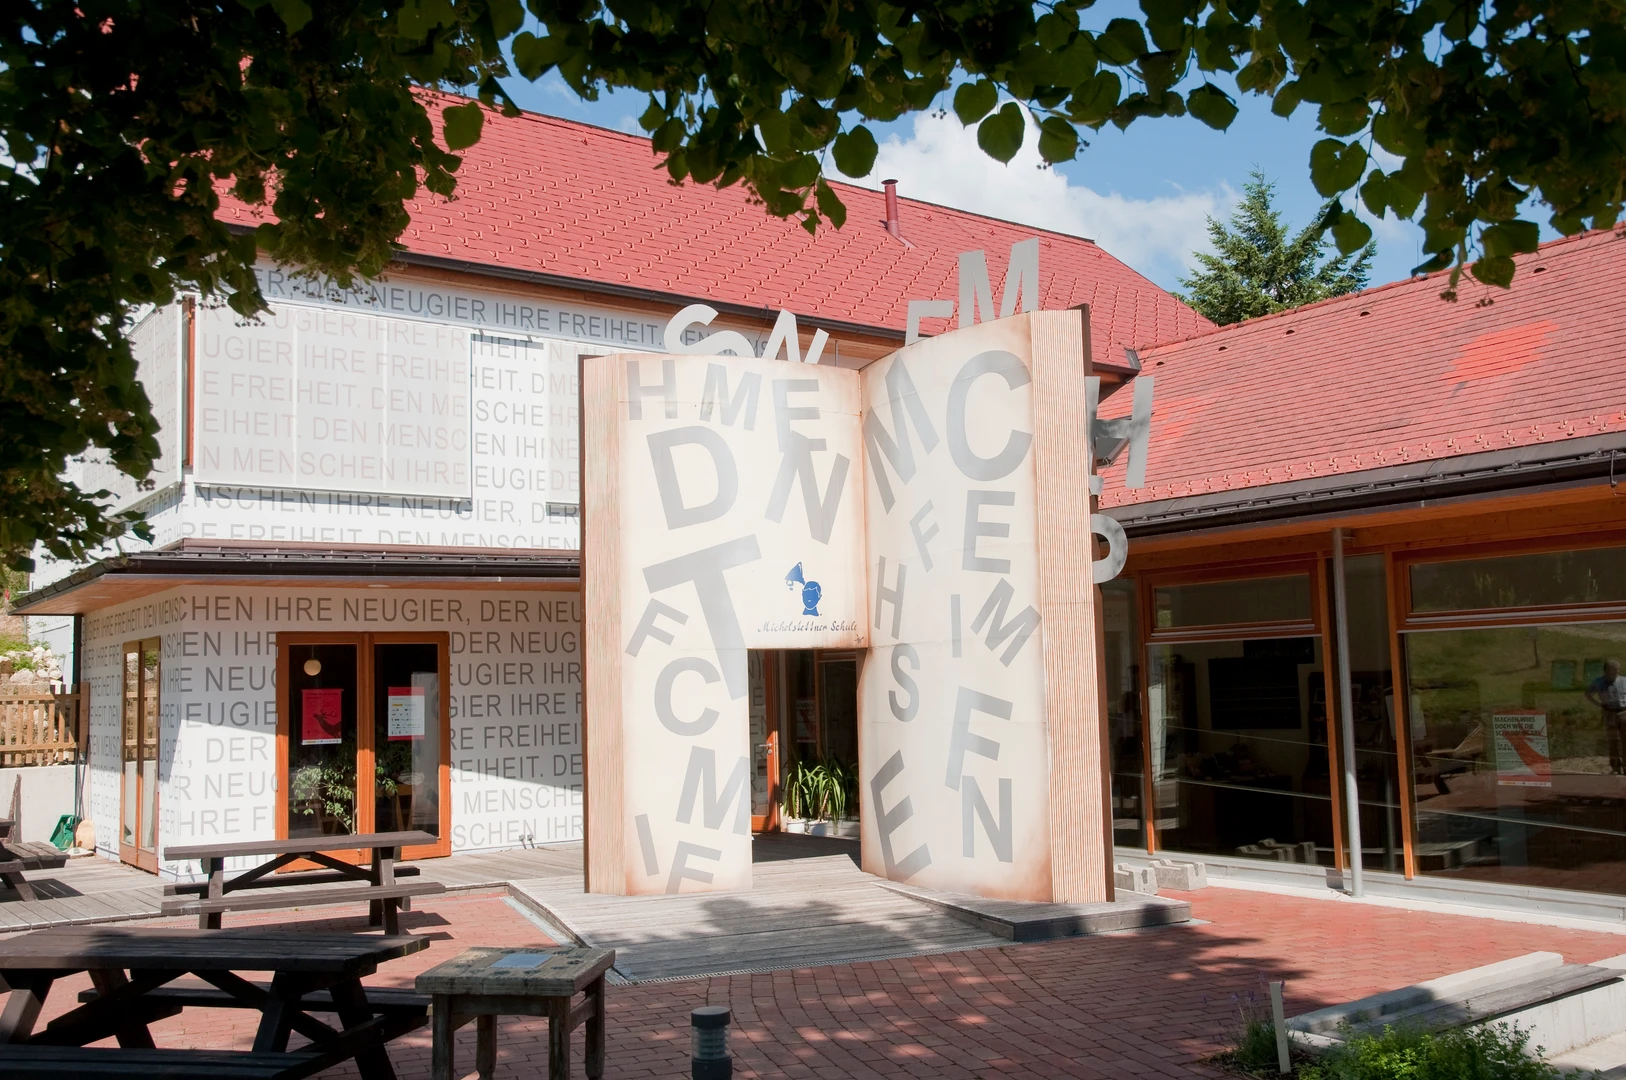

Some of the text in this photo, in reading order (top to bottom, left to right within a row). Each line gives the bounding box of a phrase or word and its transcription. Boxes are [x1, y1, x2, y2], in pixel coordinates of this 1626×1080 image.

[371, 285, 486, 322] NEUGIER
[495, 303, 551, 331] IHRE
[559, 311, 662, 346] FREIHEIT.
[203, 333, 467, 385] UGIER IHRE FREIHE
[231, 373, 361, 408] FREIHEIT.
[371, 386, 422, 414] DEN
[432, 392, 467, 418] ME
[475, 399, 544, 428] SCHE
[626, 360, 678, 420] H
[699, 362, 762, 431] M
[946, 349, 1033, 482] C
[202, 407, 467, 451] EIHEIT. DEN MENSC
[475, 432, 506, 457] EN
[862, 351, 940, 515] M
[233, 447, 396, 481] MENSCHEN
[406, 459, 467, 486] IHRE
[646, 425, 738, 530] D
[764, 429, 850, 546] N
[329, 492, 391, 517] IHRE
[401, 496, 522, 526] NEUGIER,
[909, 499, 940, 573] F
[962, 490, 1016, 574] E
[266, 596, 332, 622] IHRE
[343, 597, 470, 625] NEUGIER,
[480, 599, 530, 623] DER
[624, 597, 689, 658] F
[642, 534, 763, 701] T
[830, 620, 858, 632] Schule
[874, 555, 907, 640] H
[970, 577, 1042, 668] M
[452, 631, 501, 654] DER
[205, 665, 276, 692] NEU
[450, 662, 535, 687] UGIER
[511, 692, 567, 717] IHRE
[654, 656, 721, 737] C
[888, 642, 921, 722] S
[206, 736, 268, 764] DER
[484, 722, 582, 749] FREIHEI
[944, 685, 1013, 791] F
[464, 785, 583, 815] MENSCHE
[675, 745, 750, 836] M
[870, 749, 932, 883] E
[962, 775, 1013, 863] N
